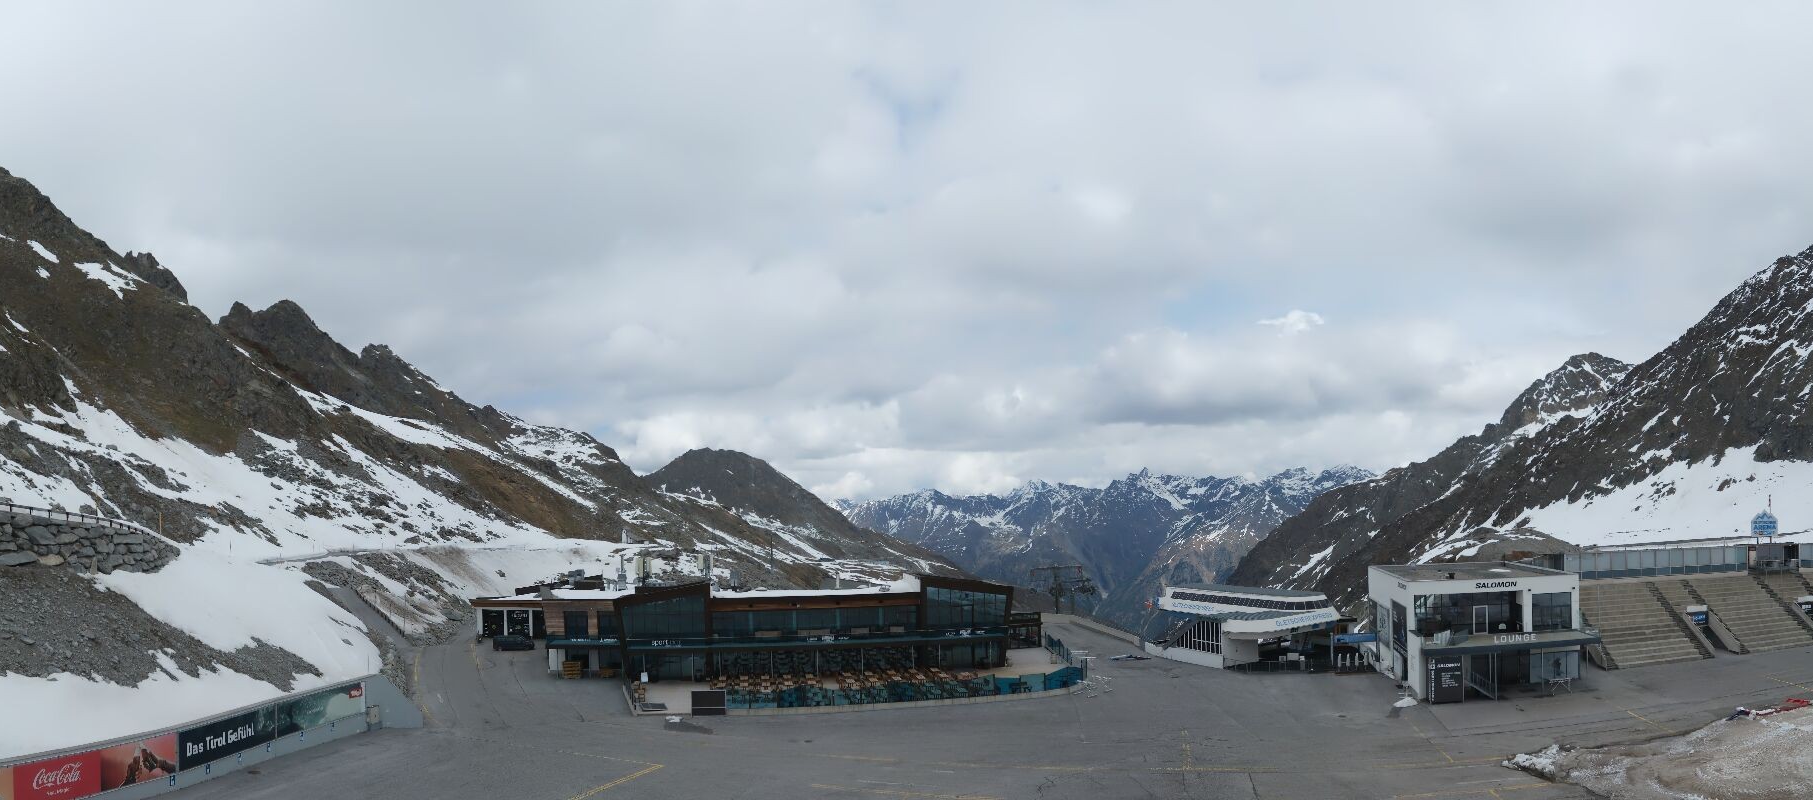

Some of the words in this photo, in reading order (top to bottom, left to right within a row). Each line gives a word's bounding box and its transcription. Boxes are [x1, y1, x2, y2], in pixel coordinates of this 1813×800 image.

[1475, 581, 1517, 589] SALOMON
[1494, 633, 1537, 644] LOUNGE
[186, 742, 204, 757] Das
[206, 731, 226, 751] Tirol
[227, 722, 255, 744] Gefühl
